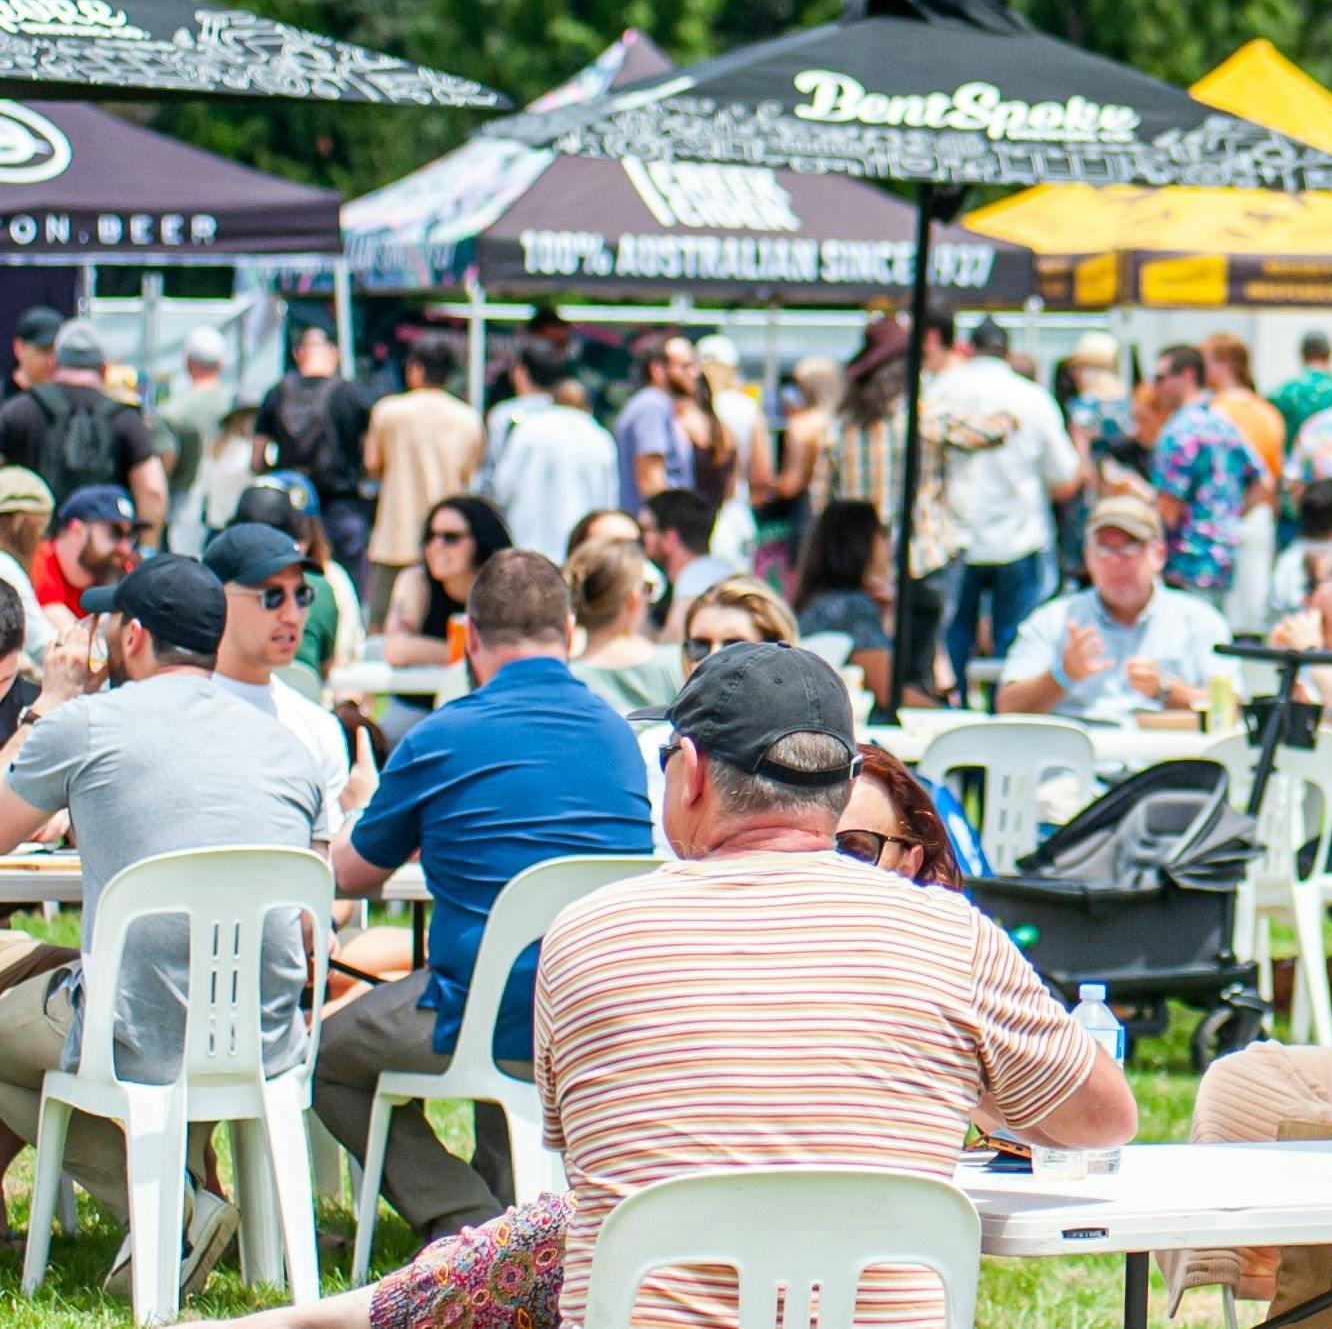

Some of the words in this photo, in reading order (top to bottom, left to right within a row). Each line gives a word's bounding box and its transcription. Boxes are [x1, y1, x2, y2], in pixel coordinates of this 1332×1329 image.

[794, 69, 1141, 140] BentSpoke
[0, 213, 218, 246] ON.BEER
[615, 233, 819, 281] AUSTRALIAN
